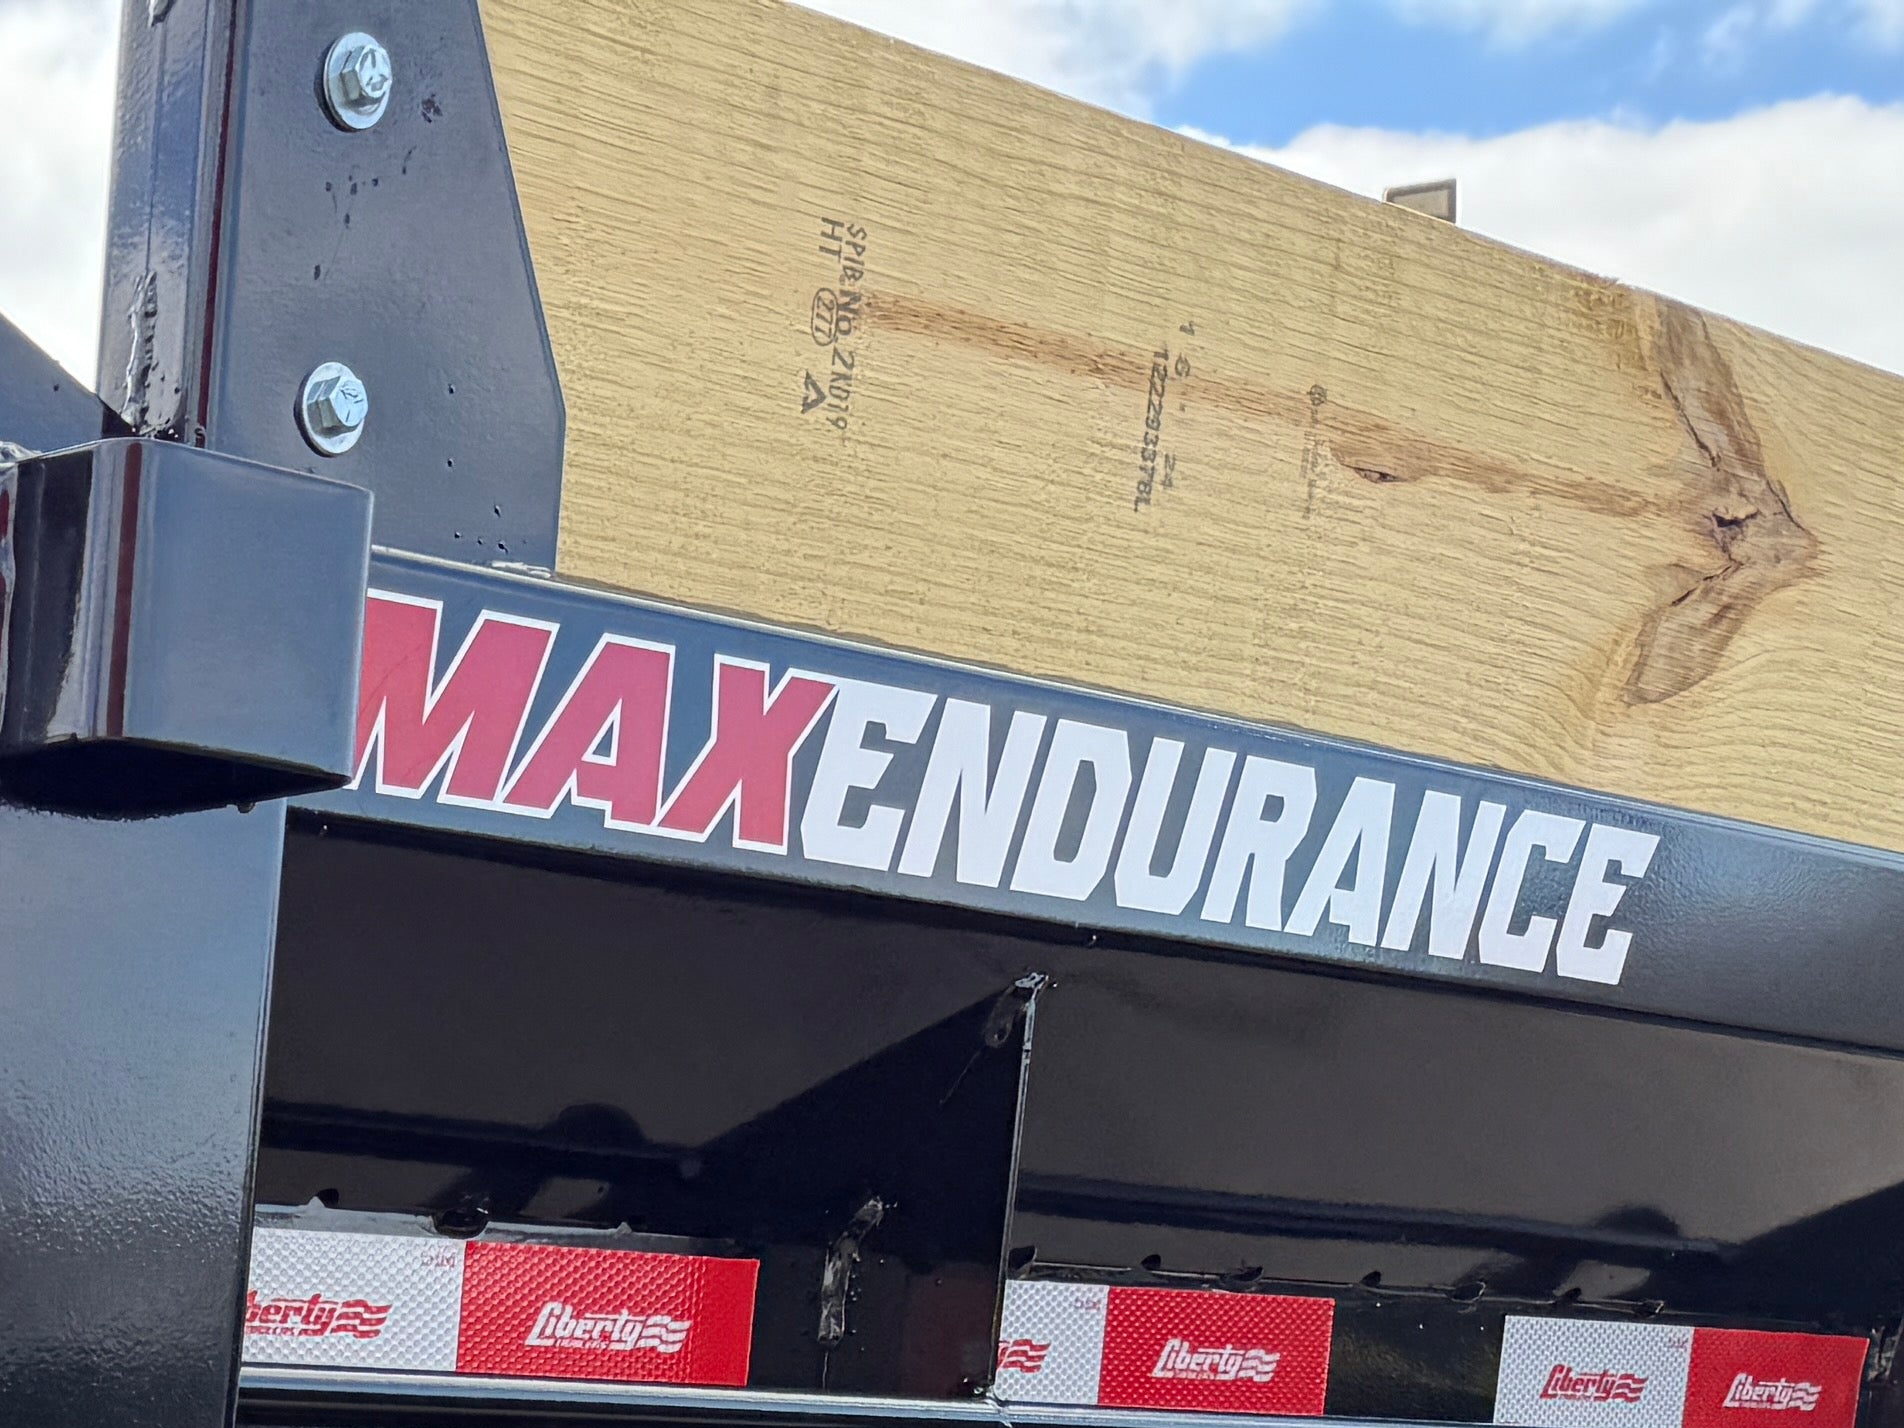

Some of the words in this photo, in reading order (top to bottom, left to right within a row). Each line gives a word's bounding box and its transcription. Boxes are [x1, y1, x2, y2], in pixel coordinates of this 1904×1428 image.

[818, 216, 845, 263] HT
[814, 295, 835, 339] 277
[246, 1290, 340, 1337] berty
[524, 1300, 647, 1351] Liberty
[1151, 1338, 1245, 1381] Liberty
[1540, 1363, 1616, 1402] Liberty
[1722, 1372, 1793, 1411] Liberty
